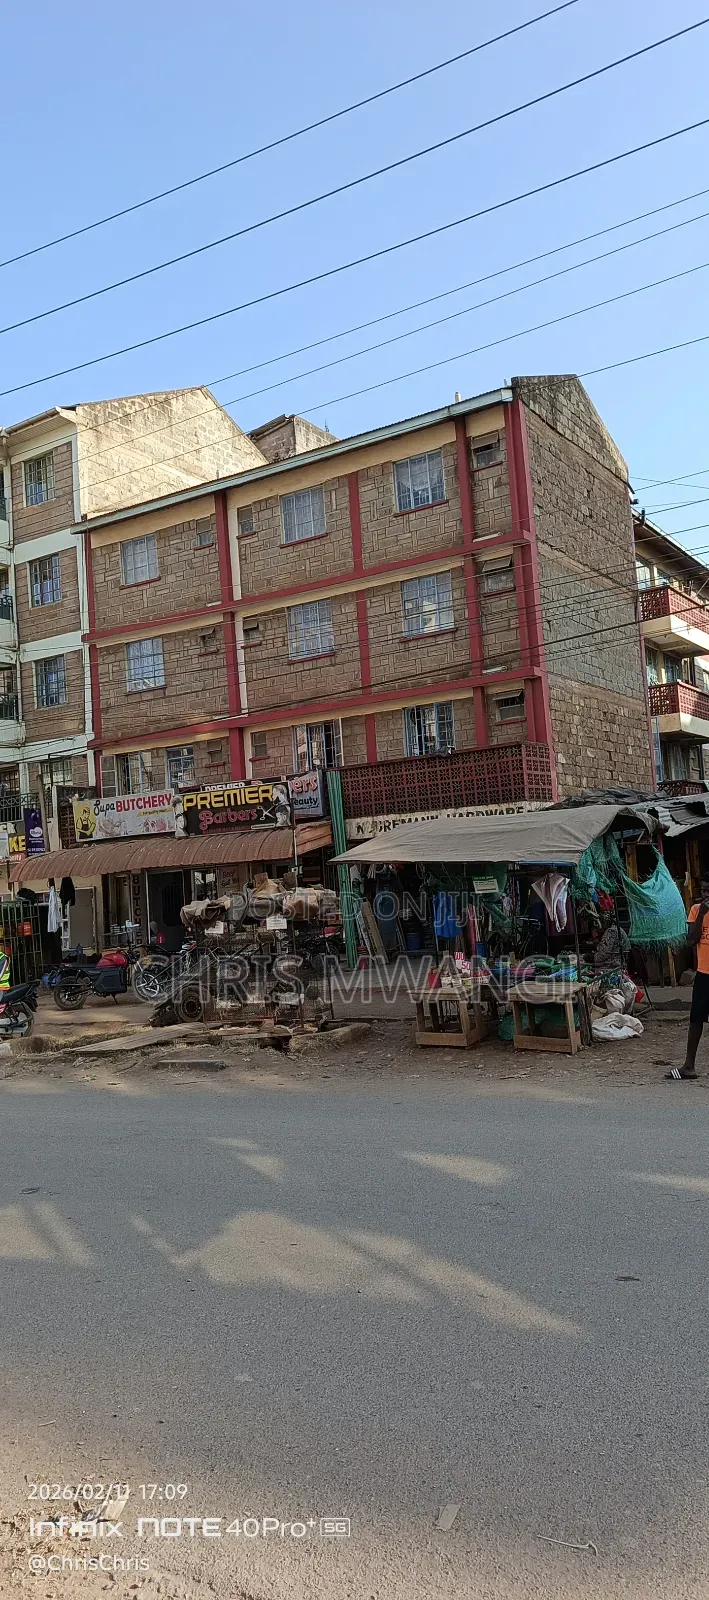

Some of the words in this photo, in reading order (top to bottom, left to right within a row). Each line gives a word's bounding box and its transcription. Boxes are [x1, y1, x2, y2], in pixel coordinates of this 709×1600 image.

[94, 800, 115, 817] Supa
[116, 793, 172, 812] BUTCHERY
[183, 785, 273, 811] PREMIER
[199, 809, 257, 830] Barbers
